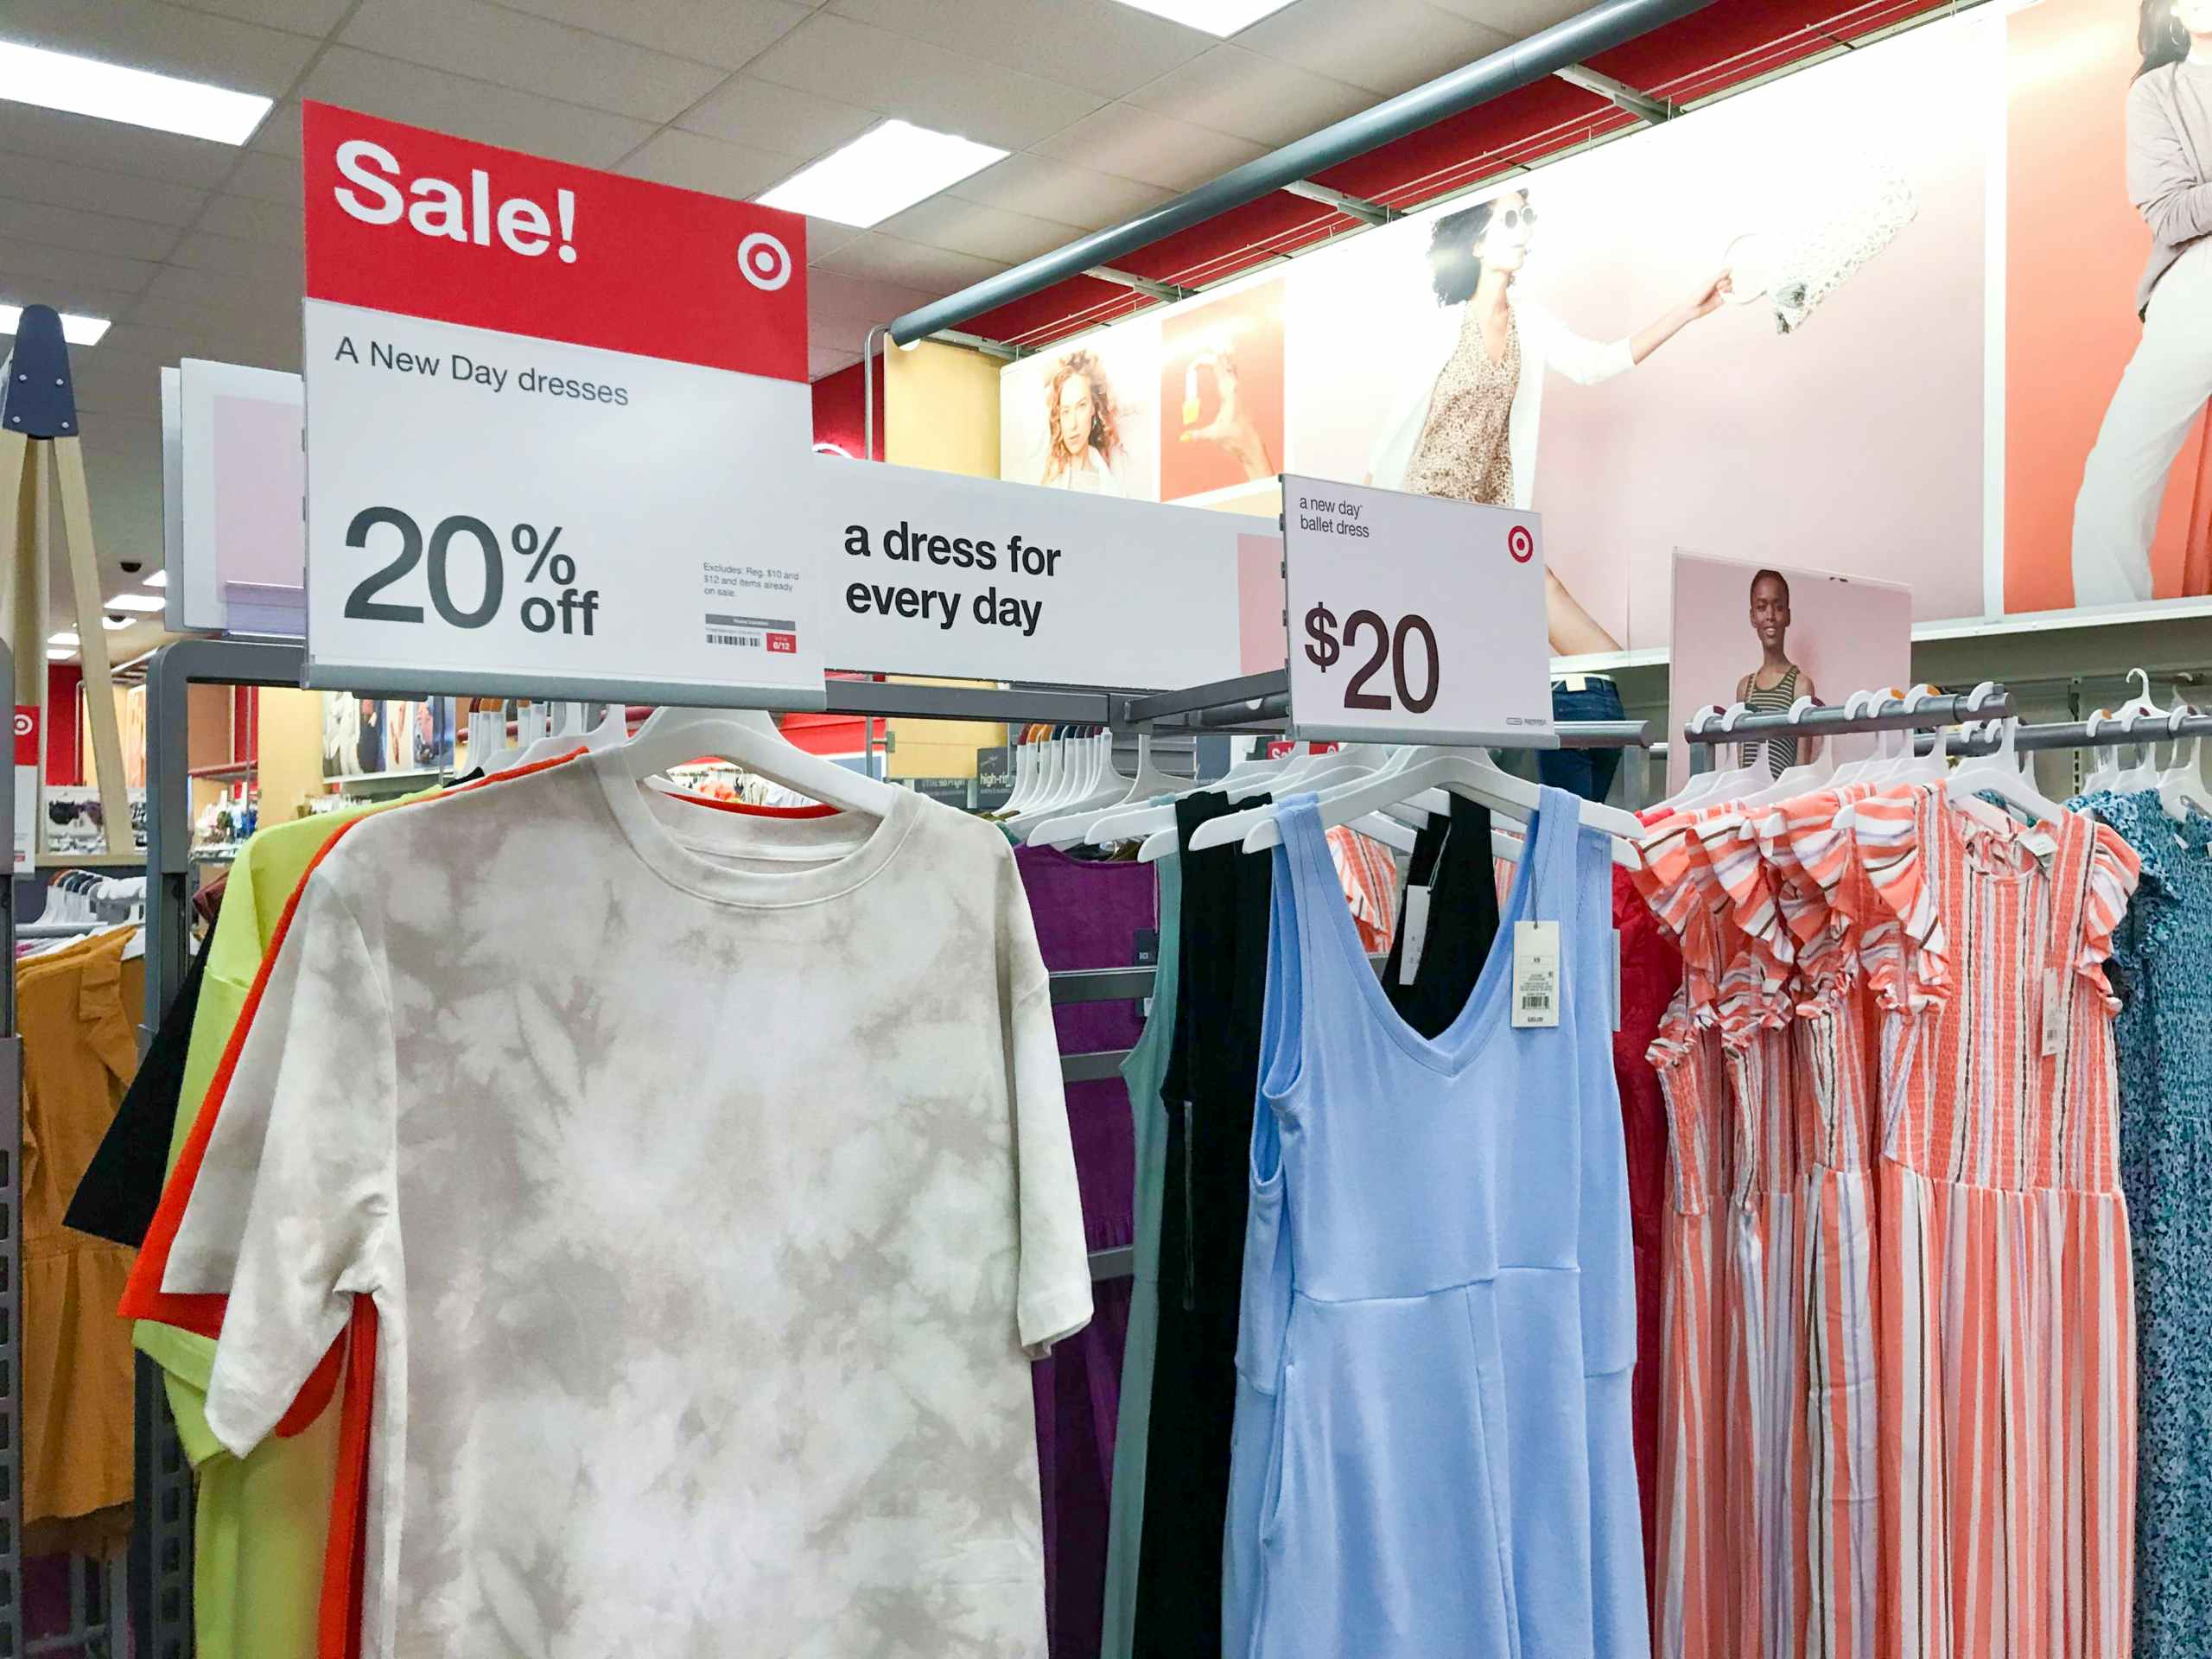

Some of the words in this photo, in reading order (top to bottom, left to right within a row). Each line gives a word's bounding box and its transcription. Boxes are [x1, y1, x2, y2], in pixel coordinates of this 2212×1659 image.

[334, 140, 576, 264] Sale!
[334, 336, 359, 364] A
[371, 340, 440, 376] New
[452, 354, 508, 393] Day
[518, 367, 629, 406] dresses
[1300, 497, 1308, 509] a
[1310, 499, 1335, 513] new
[1300, 514, 1333, 533] ballet
[1336, 520, 1370, 538] dress
[746, 567, 764, 578] Reg.
[784, 571, 800, 581] and
[844, 523, 870, 556] a
[883, 521, 997, 570] dress
[1007, 535, 1062, 576] for
[721, 576, 737, 586] and
[740, 578, 762, 588] items
[764, 582, 793, 593] already
[846, 581, 962, 630] every
[973, 587, 1043, 637] day
[520, 588, 599, 636] off
[1304, 601, 1440, 714] $20
